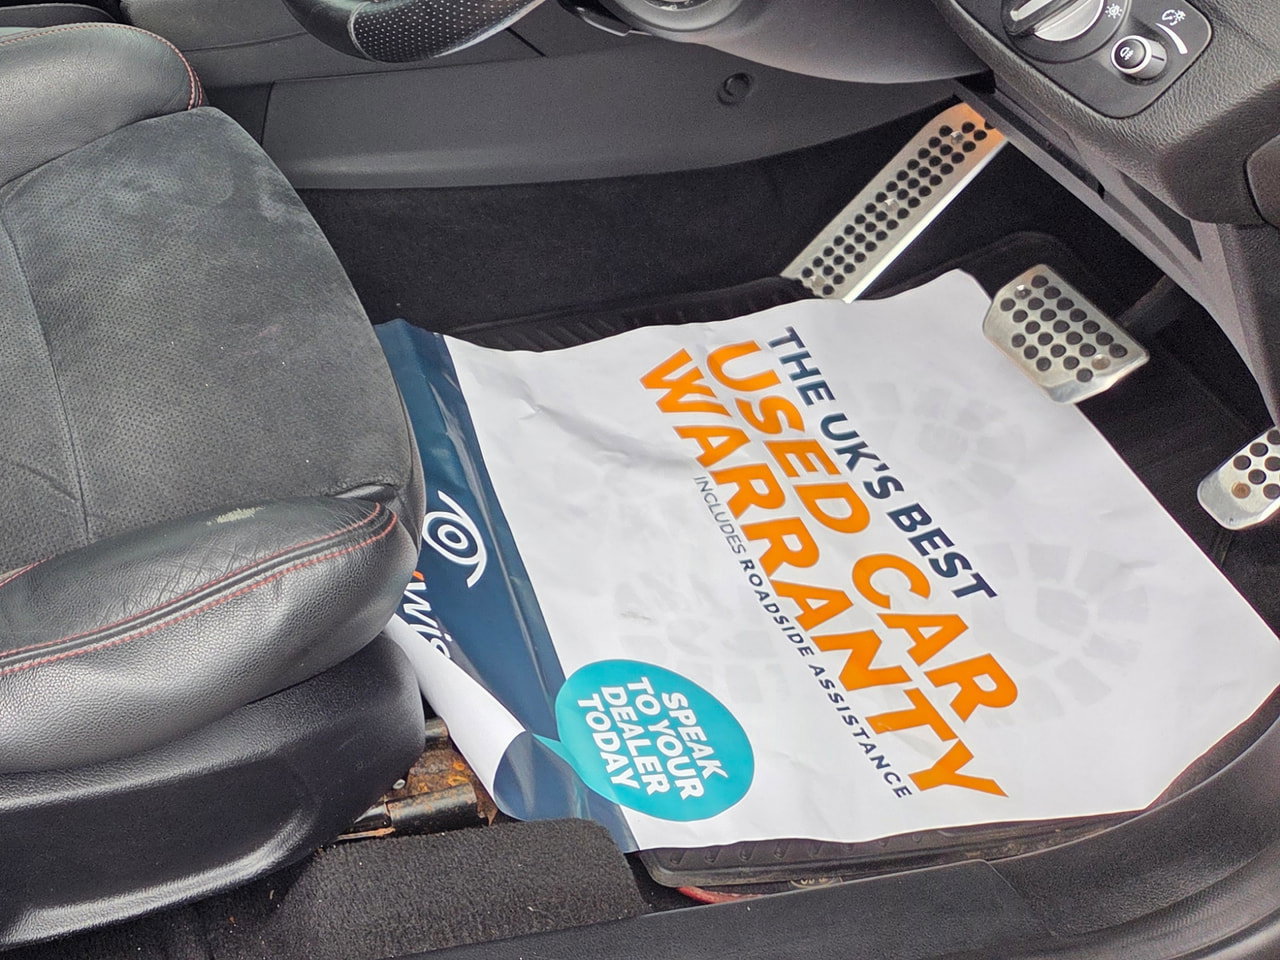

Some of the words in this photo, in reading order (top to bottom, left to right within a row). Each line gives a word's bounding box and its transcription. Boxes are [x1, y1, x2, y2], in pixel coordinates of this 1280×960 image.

[706, 339, 871, 534] USED
[851, 552, 1018, 723] CAR
[767, 326, 836, 407] THE
[820, 412, 905, 500] UK'S
[886, 502, 998, 599] BEST
[639, 347, 1009, 798] WARRANTY
[693, 476, 747, 555] INCLUDES
[739, 559, 815, 657] ROADSIDE
[808, 663, 912, 798] ASSISTANCE
[577, 692, 640, 789] TODAY
[600, 686, 671, 796] DEALER
[627, 676, 662, 716] TO
[647, 719, 705, 801] YOUR
[661, 692, 729, 779] SPEAK
